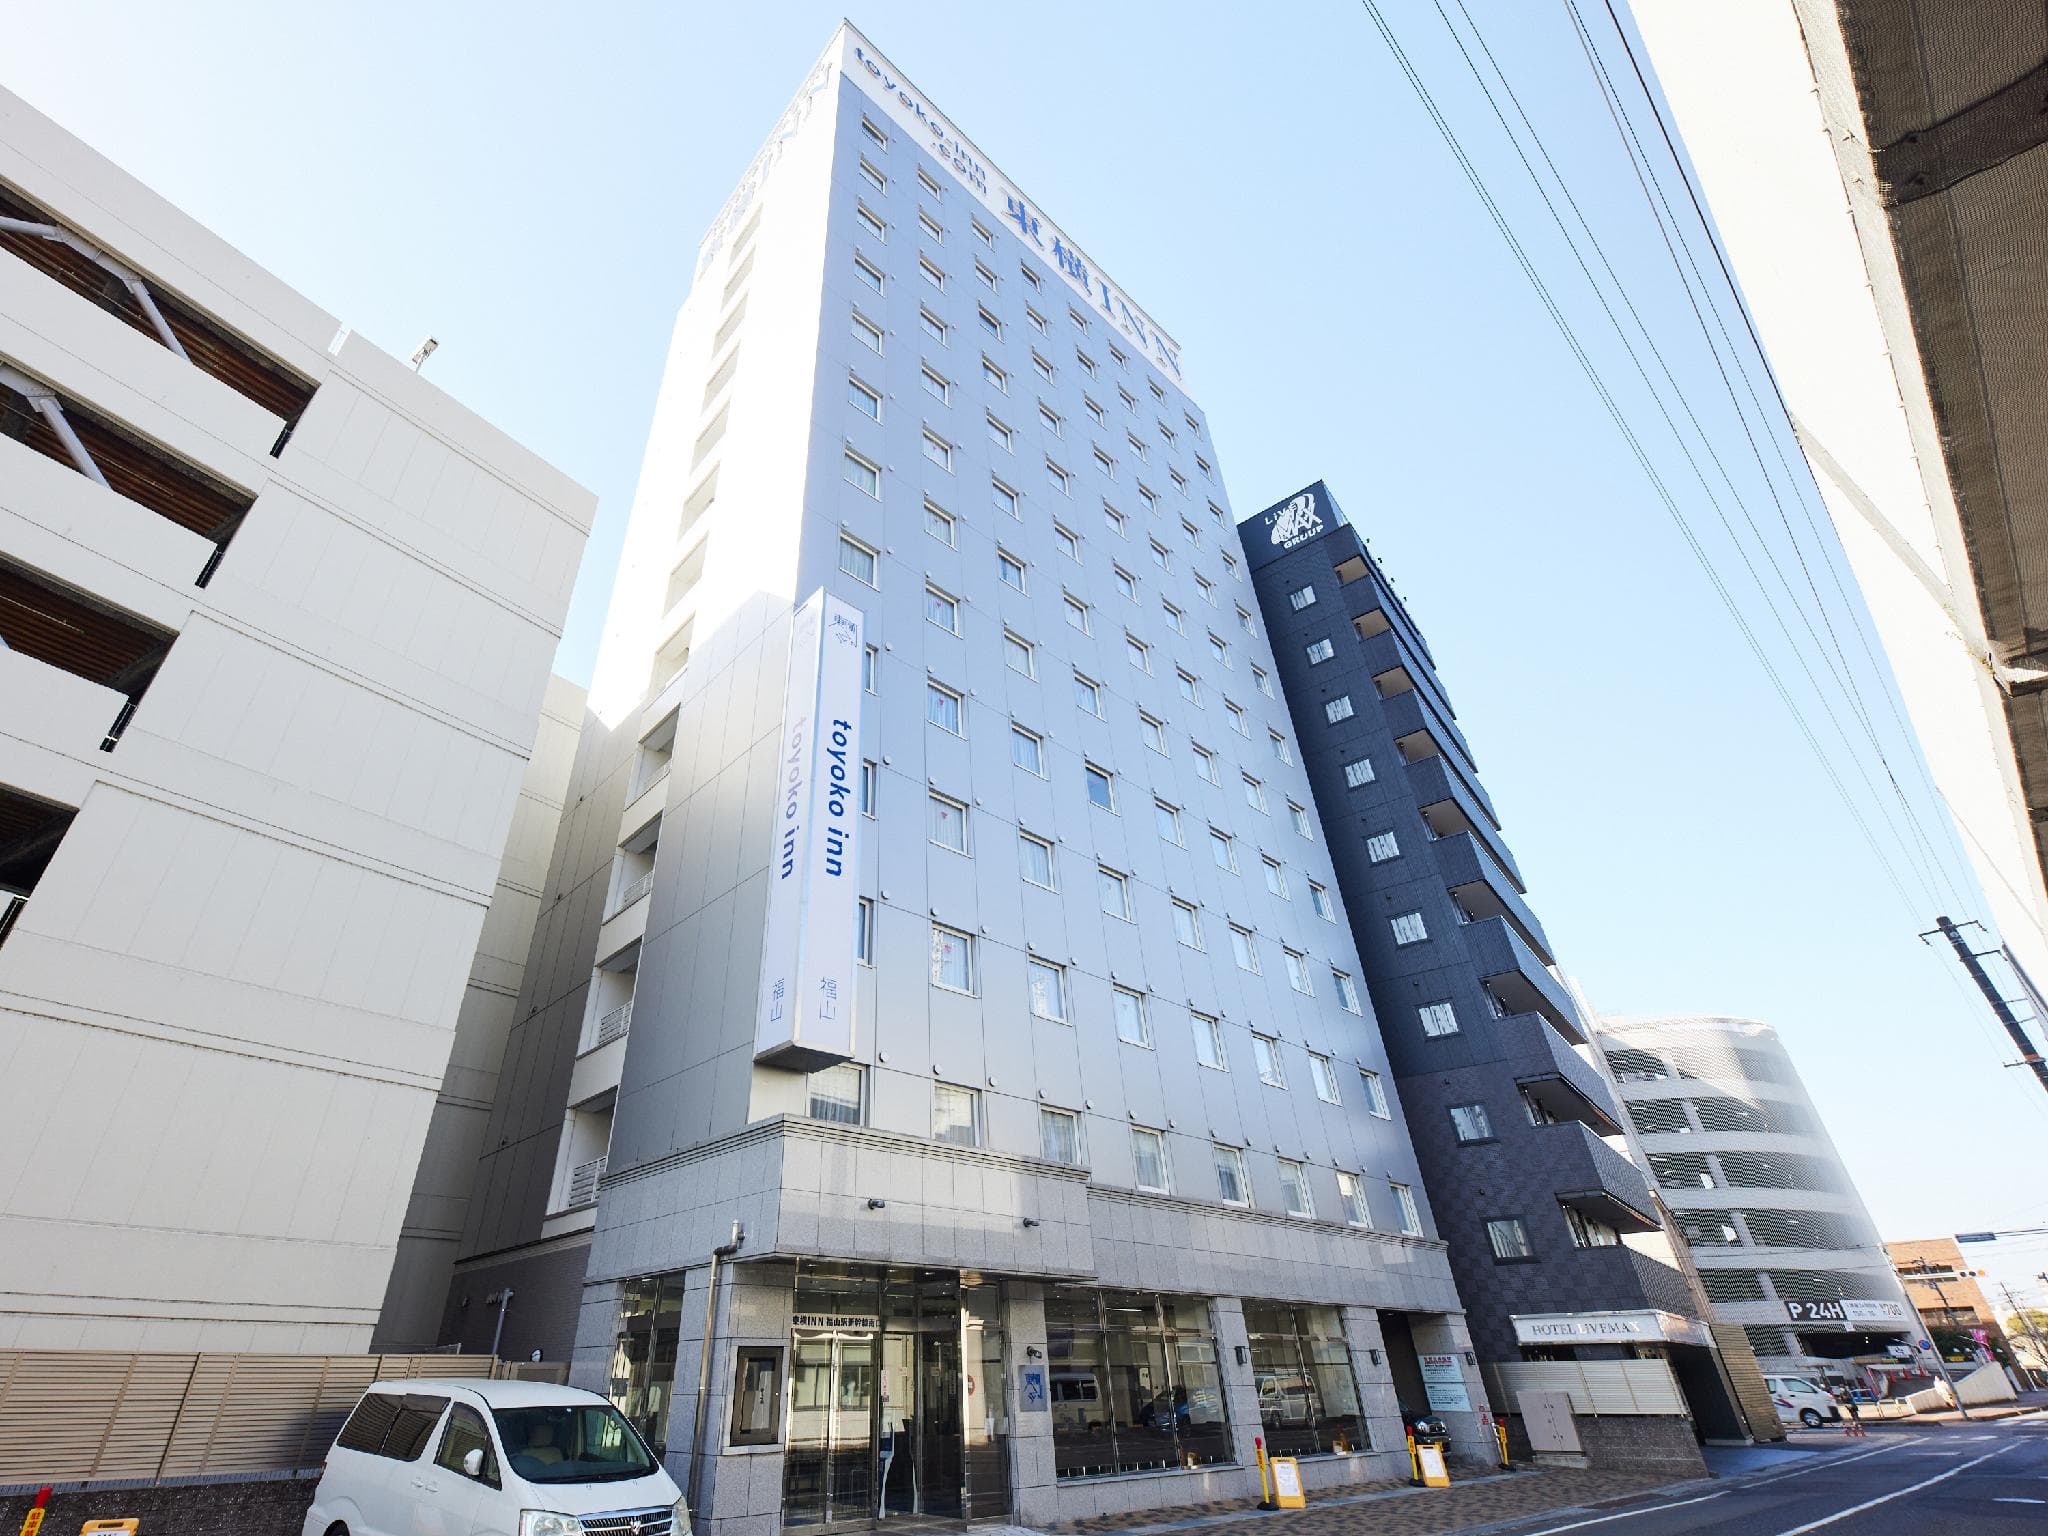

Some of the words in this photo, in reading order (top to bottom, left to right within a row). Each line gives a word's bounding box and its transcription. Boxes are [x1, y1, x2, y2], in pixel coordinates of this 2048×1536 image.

[786, 717, 807, 820] toyoko
[826, 719, 852, 817] toyoko
[781, 825, 800, 880] inn
[825, 826, 850, 878] inn
[1532, 1323, 1577, 1336] HOTEL
[1788, 1302, 1803, 1319] P
[1806, 1302, 1845, 1319] 24H
